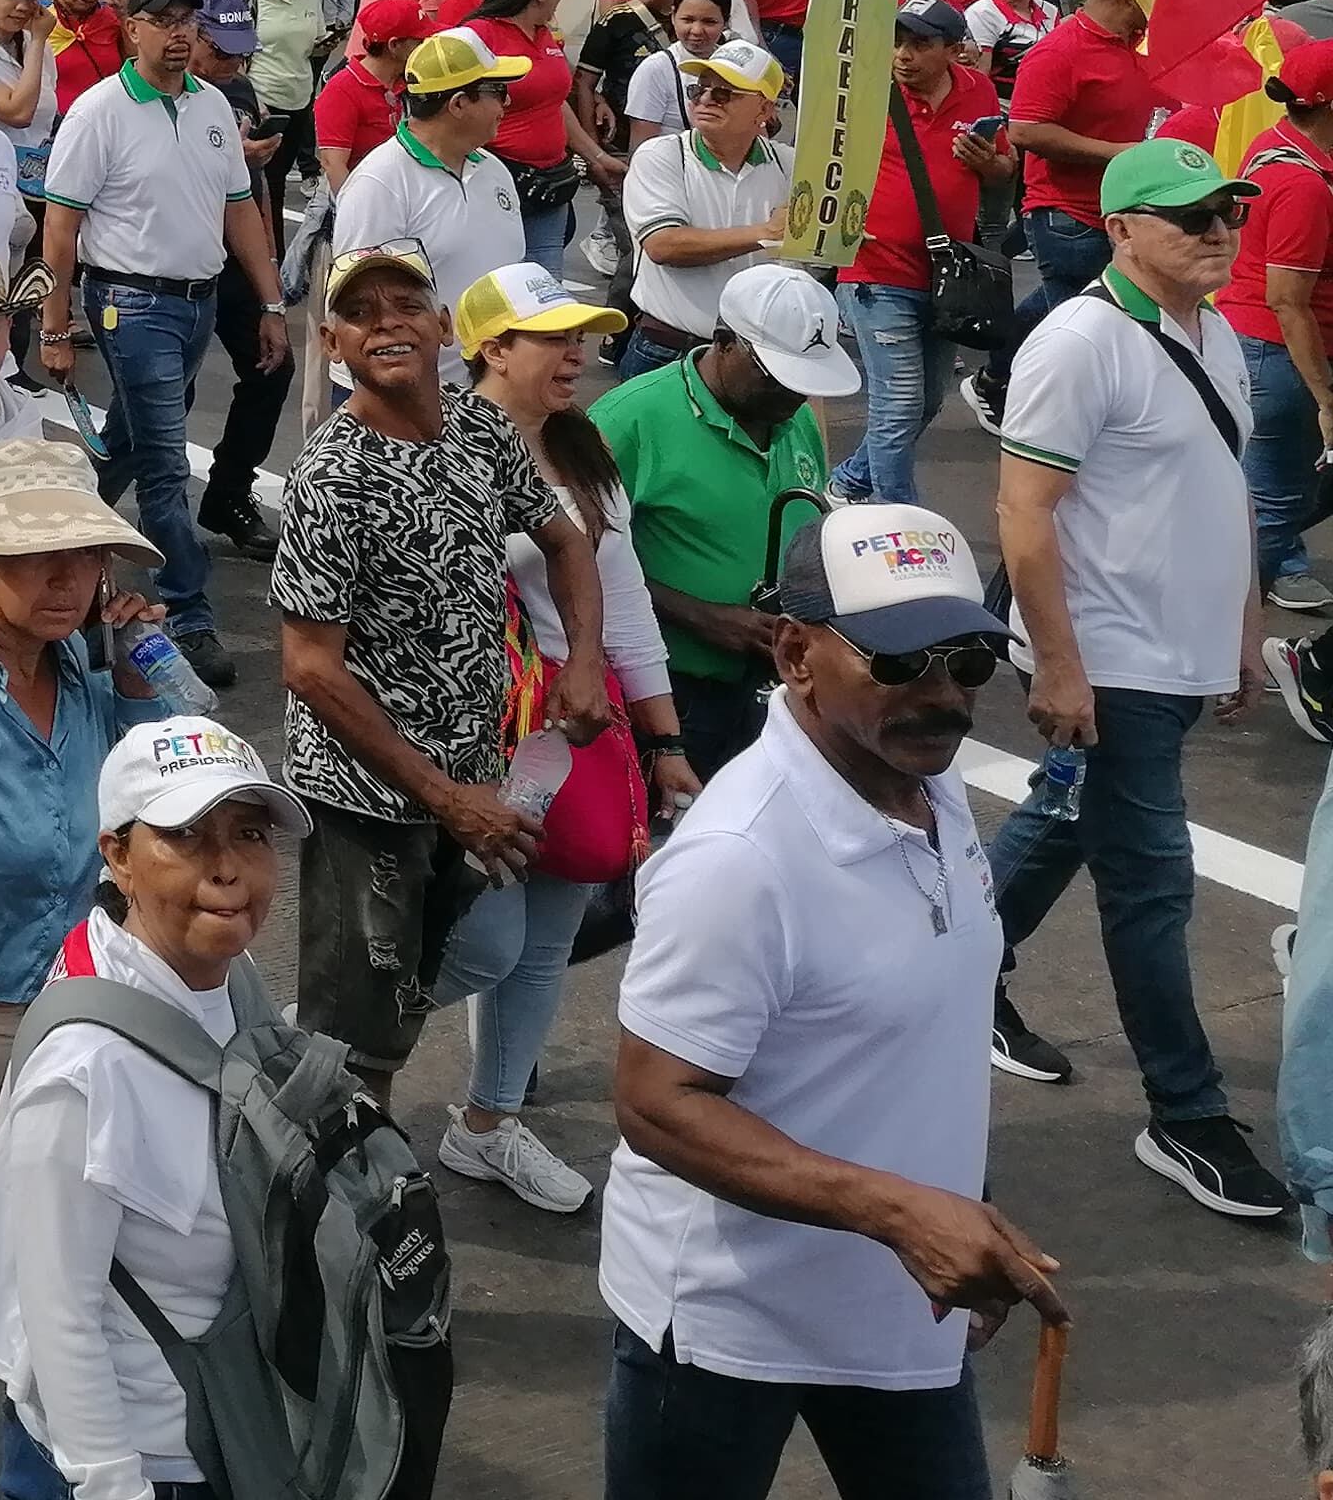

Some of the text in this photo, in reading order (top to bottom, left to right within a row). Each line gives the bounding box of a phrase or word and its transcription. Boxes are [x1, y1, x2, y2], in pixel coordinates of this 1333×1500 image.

[852, 530, 937, 557] PETRO
[884, 547, 948, 567] PACTO
[152, 731, 242, 762] PETRO
[380, 1228, 423, 1268] Liberty
[393, 1240, 435, 1281] Seguros
